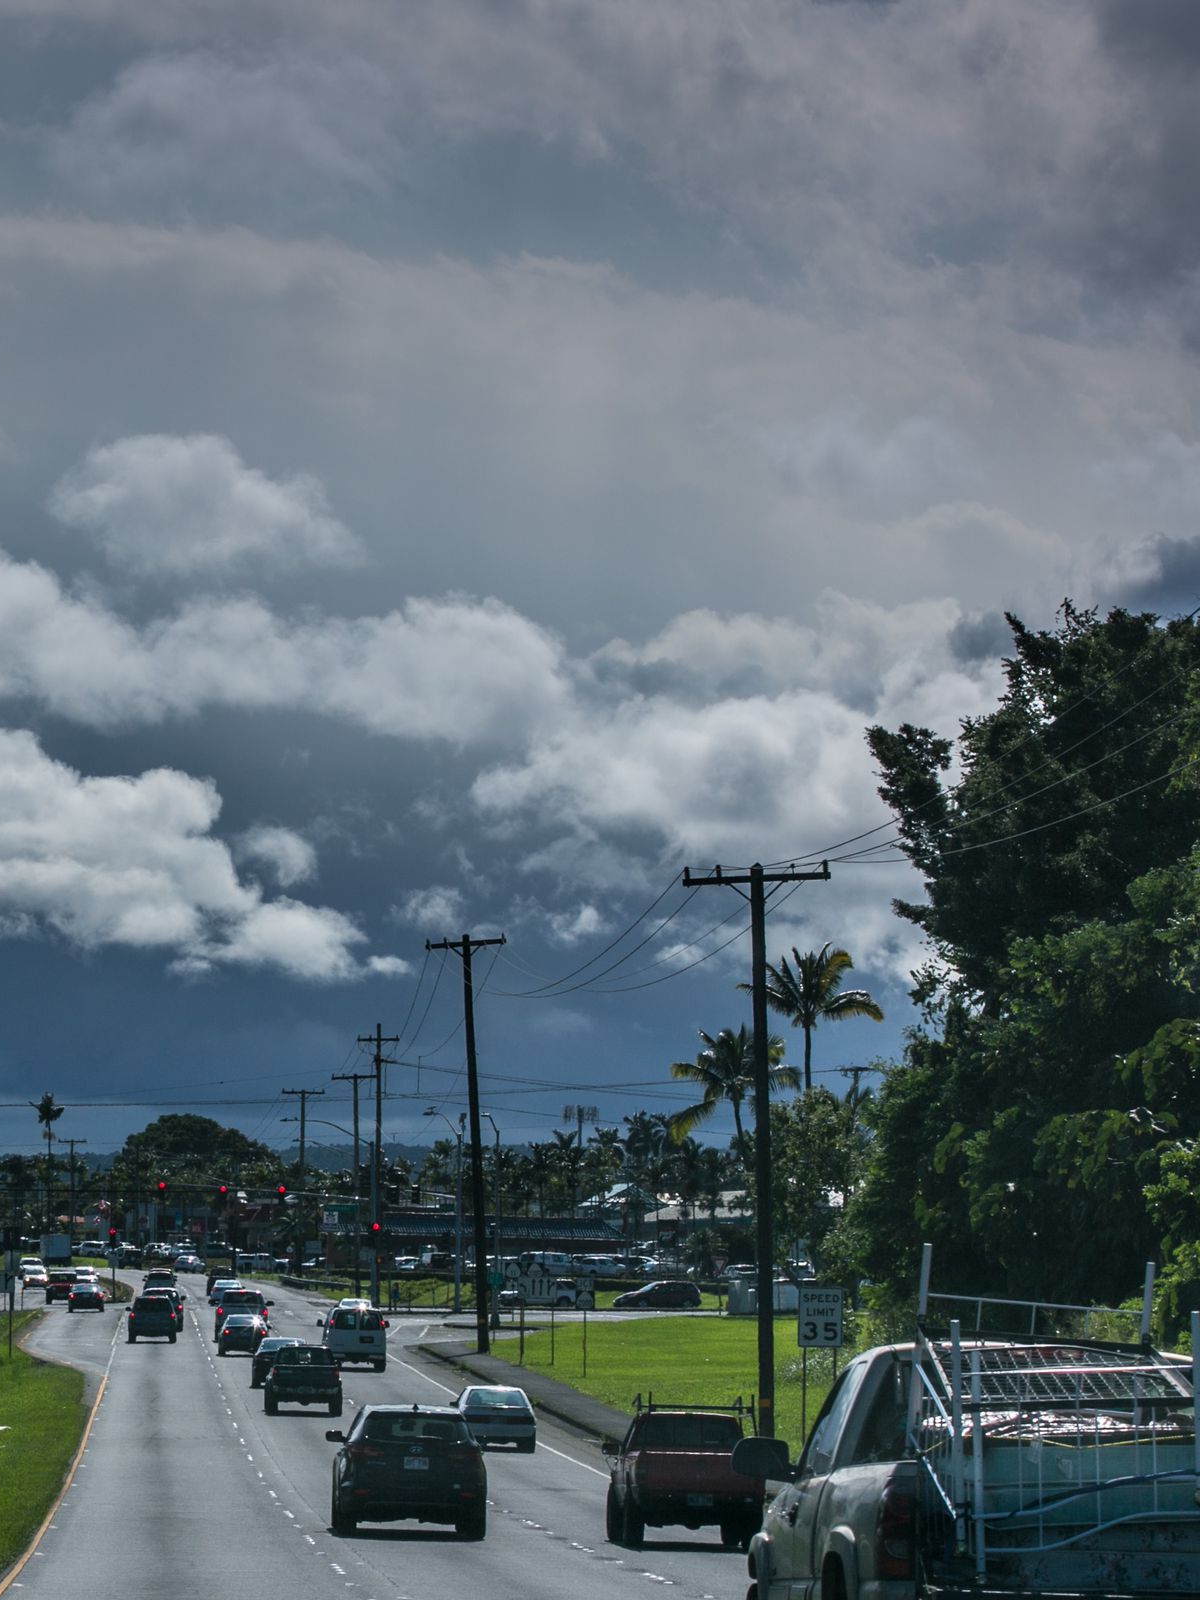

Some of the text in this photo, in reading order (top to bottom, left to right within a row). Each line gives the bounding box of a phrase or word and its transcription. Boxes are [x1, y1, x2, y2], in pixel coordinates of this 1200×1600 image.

[803, 1294, 840, 1303] SPEED
[806, 1307, 836, 1317] LIMIT
[803, 1321, 838, 1341] 35
